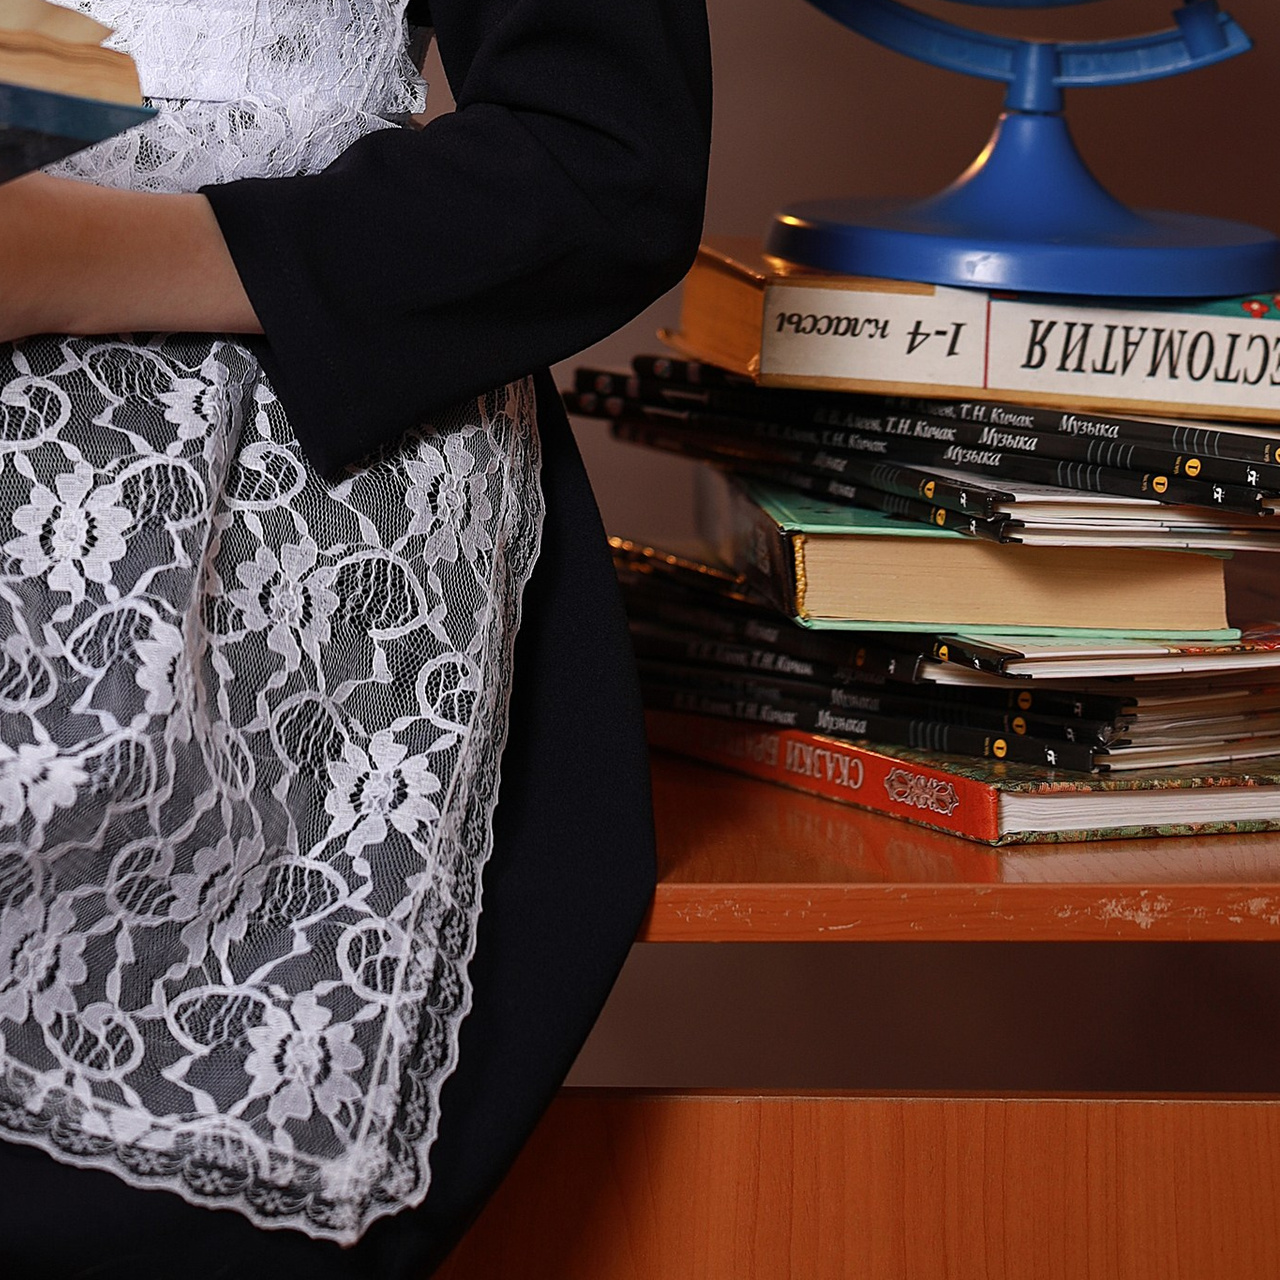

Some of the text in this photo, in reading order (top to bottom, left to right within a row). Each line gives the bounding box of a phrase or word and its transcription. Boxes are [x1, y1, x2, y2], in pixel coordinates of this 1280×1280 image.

[776, 310, 968, 358] 1-4 классы
[1020, 318, 1280, 388] СТОМАТИЯ
[990, 407, 1035, 428] Кичак
[1057, 414, 1120, 439] Музыка
[978, 426, 1039, 451] Музыка
[942, 445, 1002, 466] Музыка
[785, 739, 864, 790] СКАЗКИ
